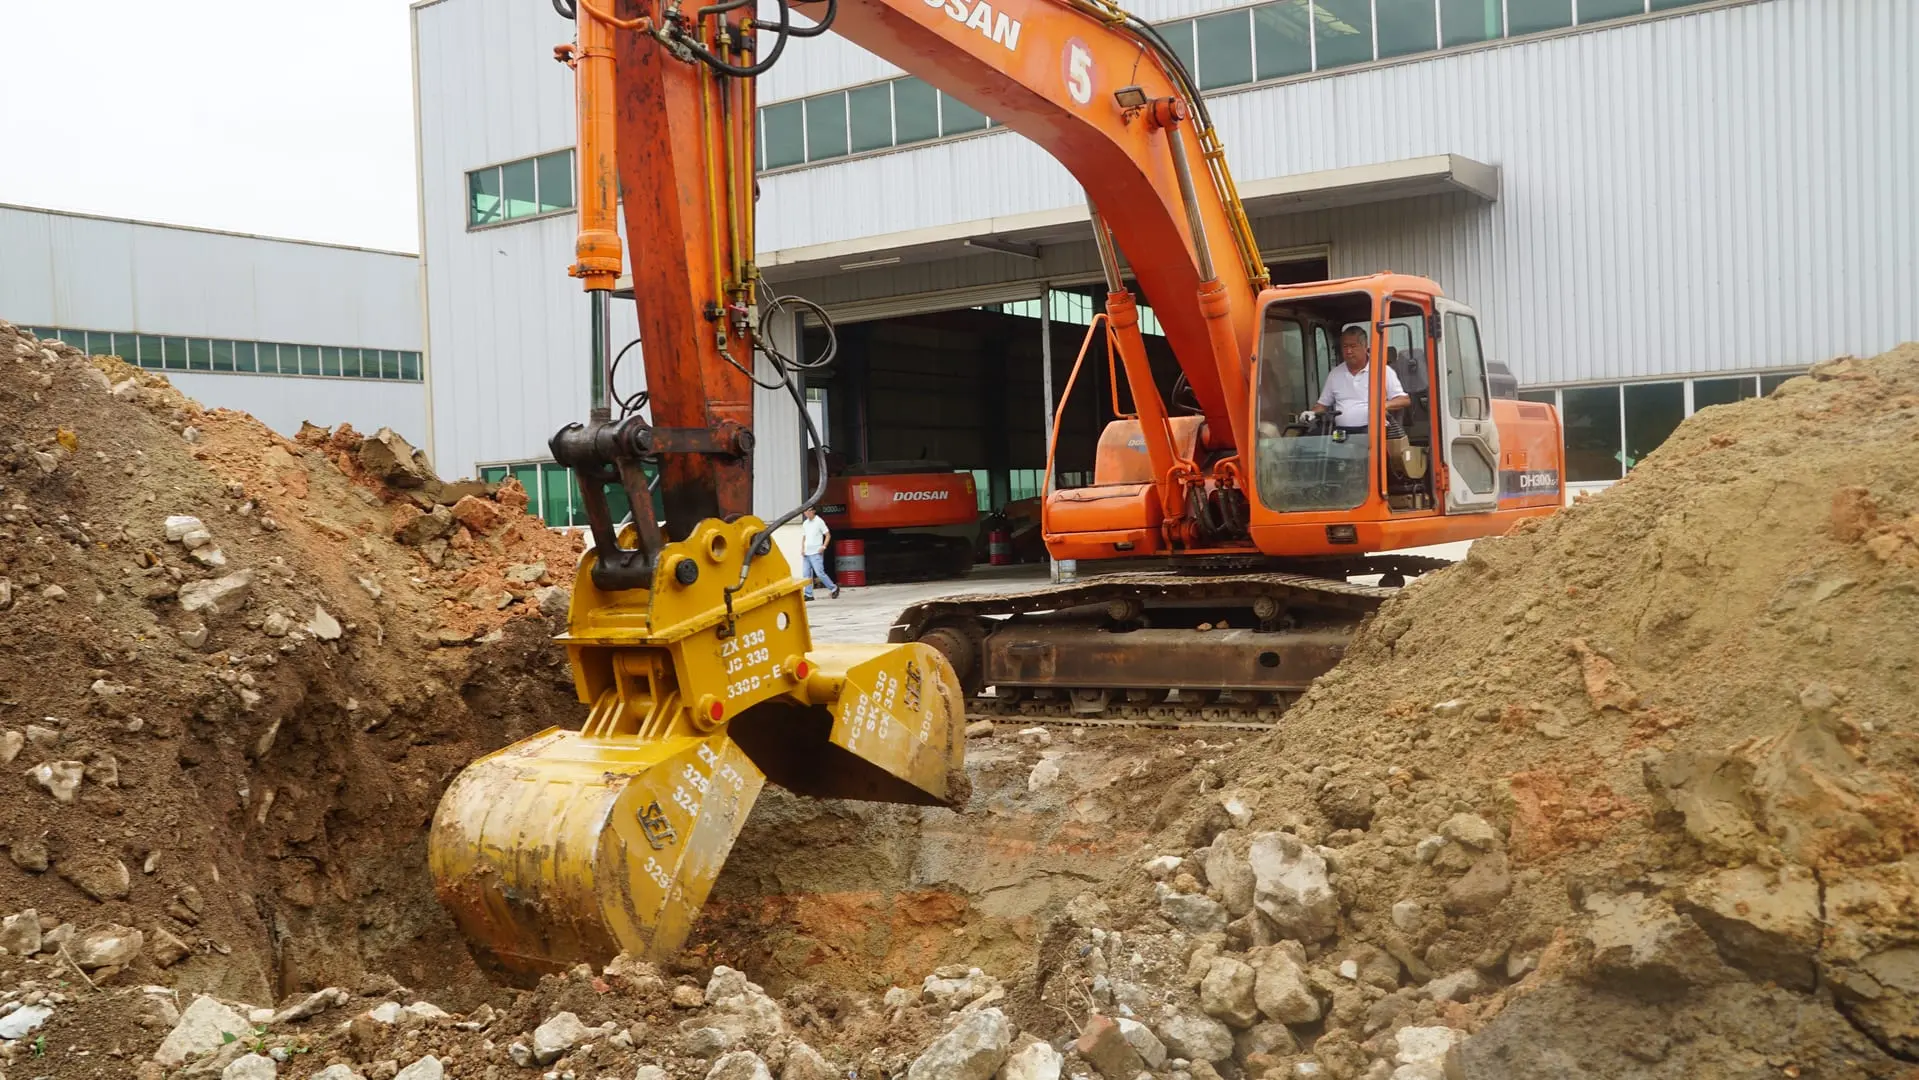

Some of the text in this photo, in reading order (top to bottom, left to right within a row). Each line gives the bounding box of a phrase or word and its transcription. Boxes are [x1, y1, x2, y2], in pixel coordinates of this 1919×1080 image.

[923, 0, 1021, 51] SAN
[1068, 43, 1091, 104] 5
[893, 490, 949, 501] DOOSAN
[721, 628, 765, 657] ZX 330
[746, 647, 769, 667] 330
[866, 670, 887, 732] SK 330
[878, 677, 898, 739] CX 330
[847, 694, 869, 752] PC300
[697, 742, 719, 768] ZX
[683, 764, 709, 792] 325
[672, 785, 699, 816] 324
[643, 856, 669, 889] 329
